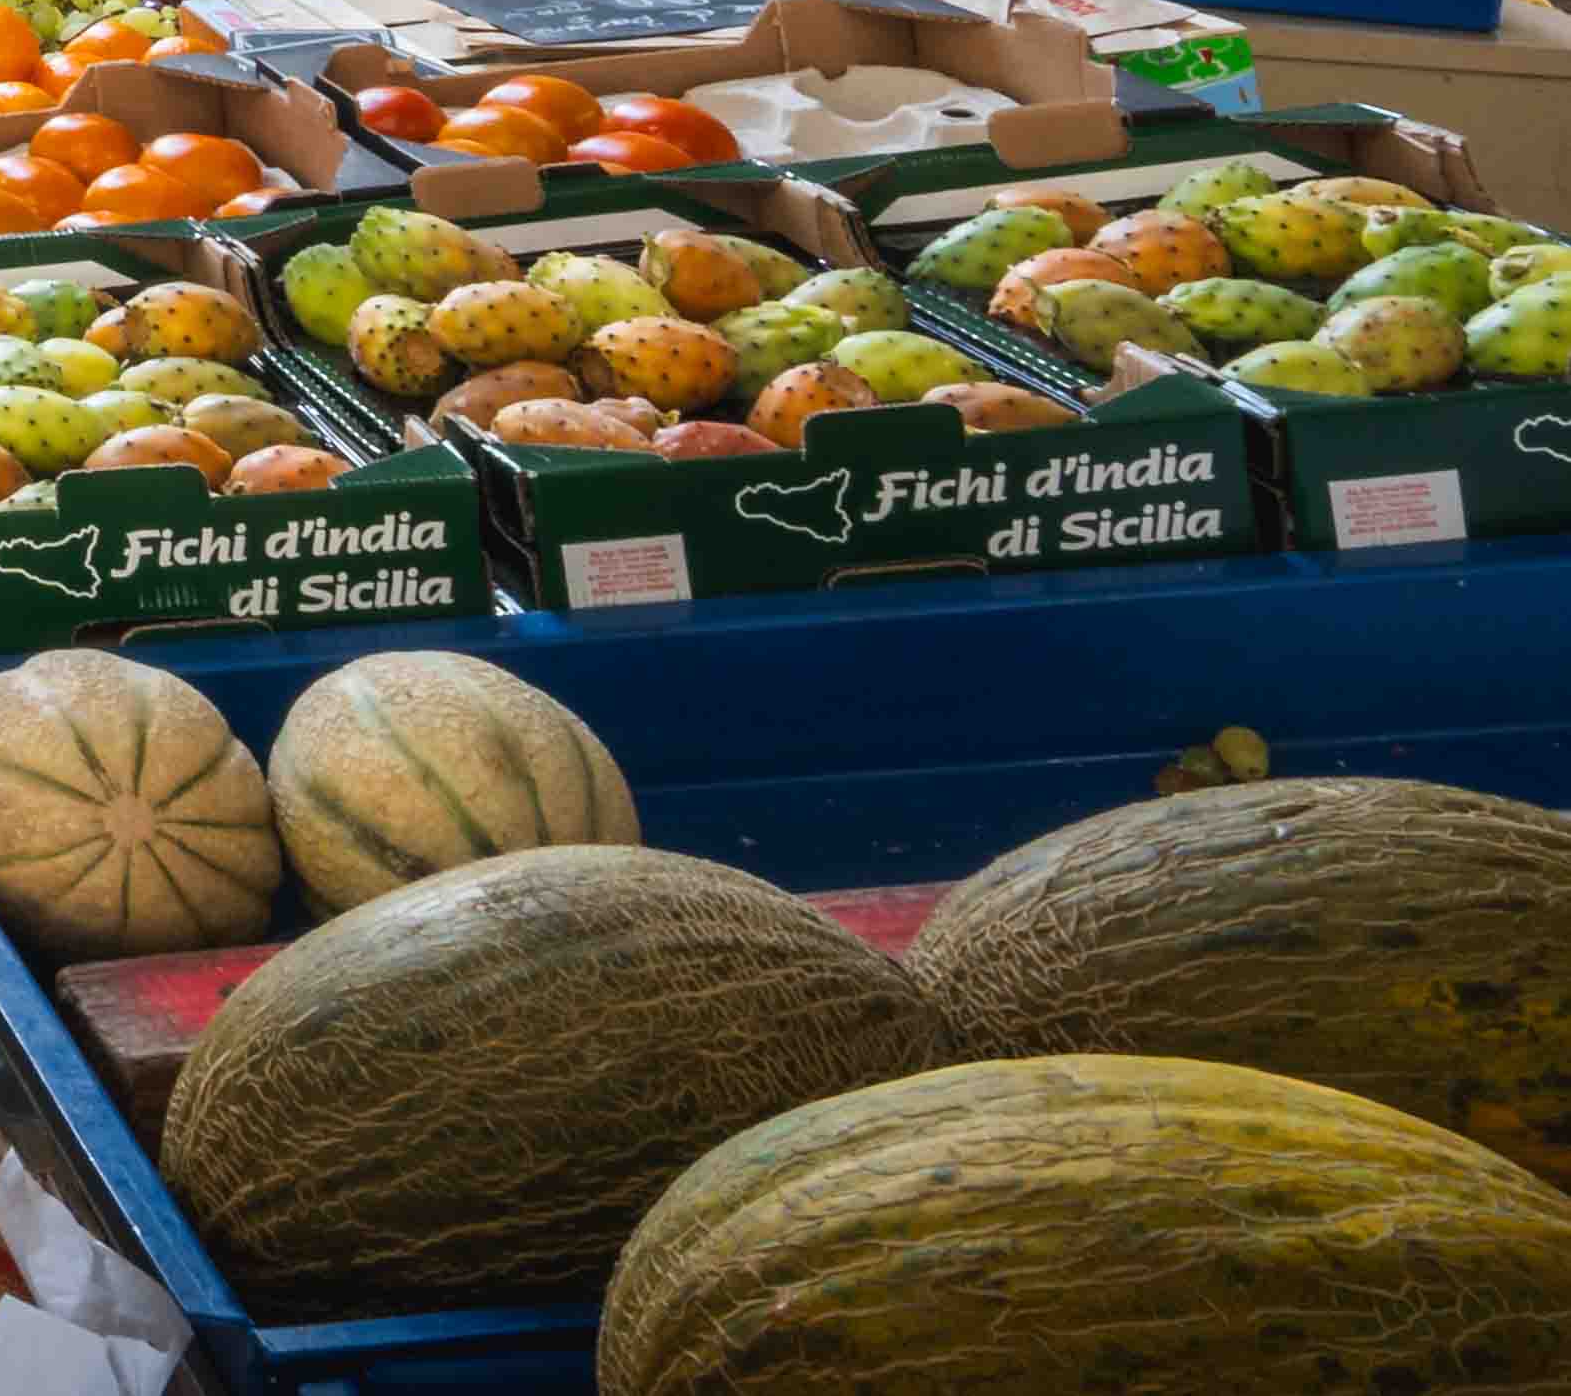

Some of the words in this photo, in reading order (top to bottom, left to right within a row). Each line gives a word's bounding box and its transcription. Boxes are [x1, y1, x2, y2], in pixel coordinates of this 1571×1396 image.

[863, 462, 1007, 521] Fichi
[1025, 443, 1215, 497] d'india
[111, 522, 248, 579] Fichi
[264, 511, 447, 559] d'india
[987, 515, 1040, 558] di
[1060, 500, 1223, 551] Sicilia
[229, 576, 280, 618] di
[297, 567, 454, 613] Sicilia
